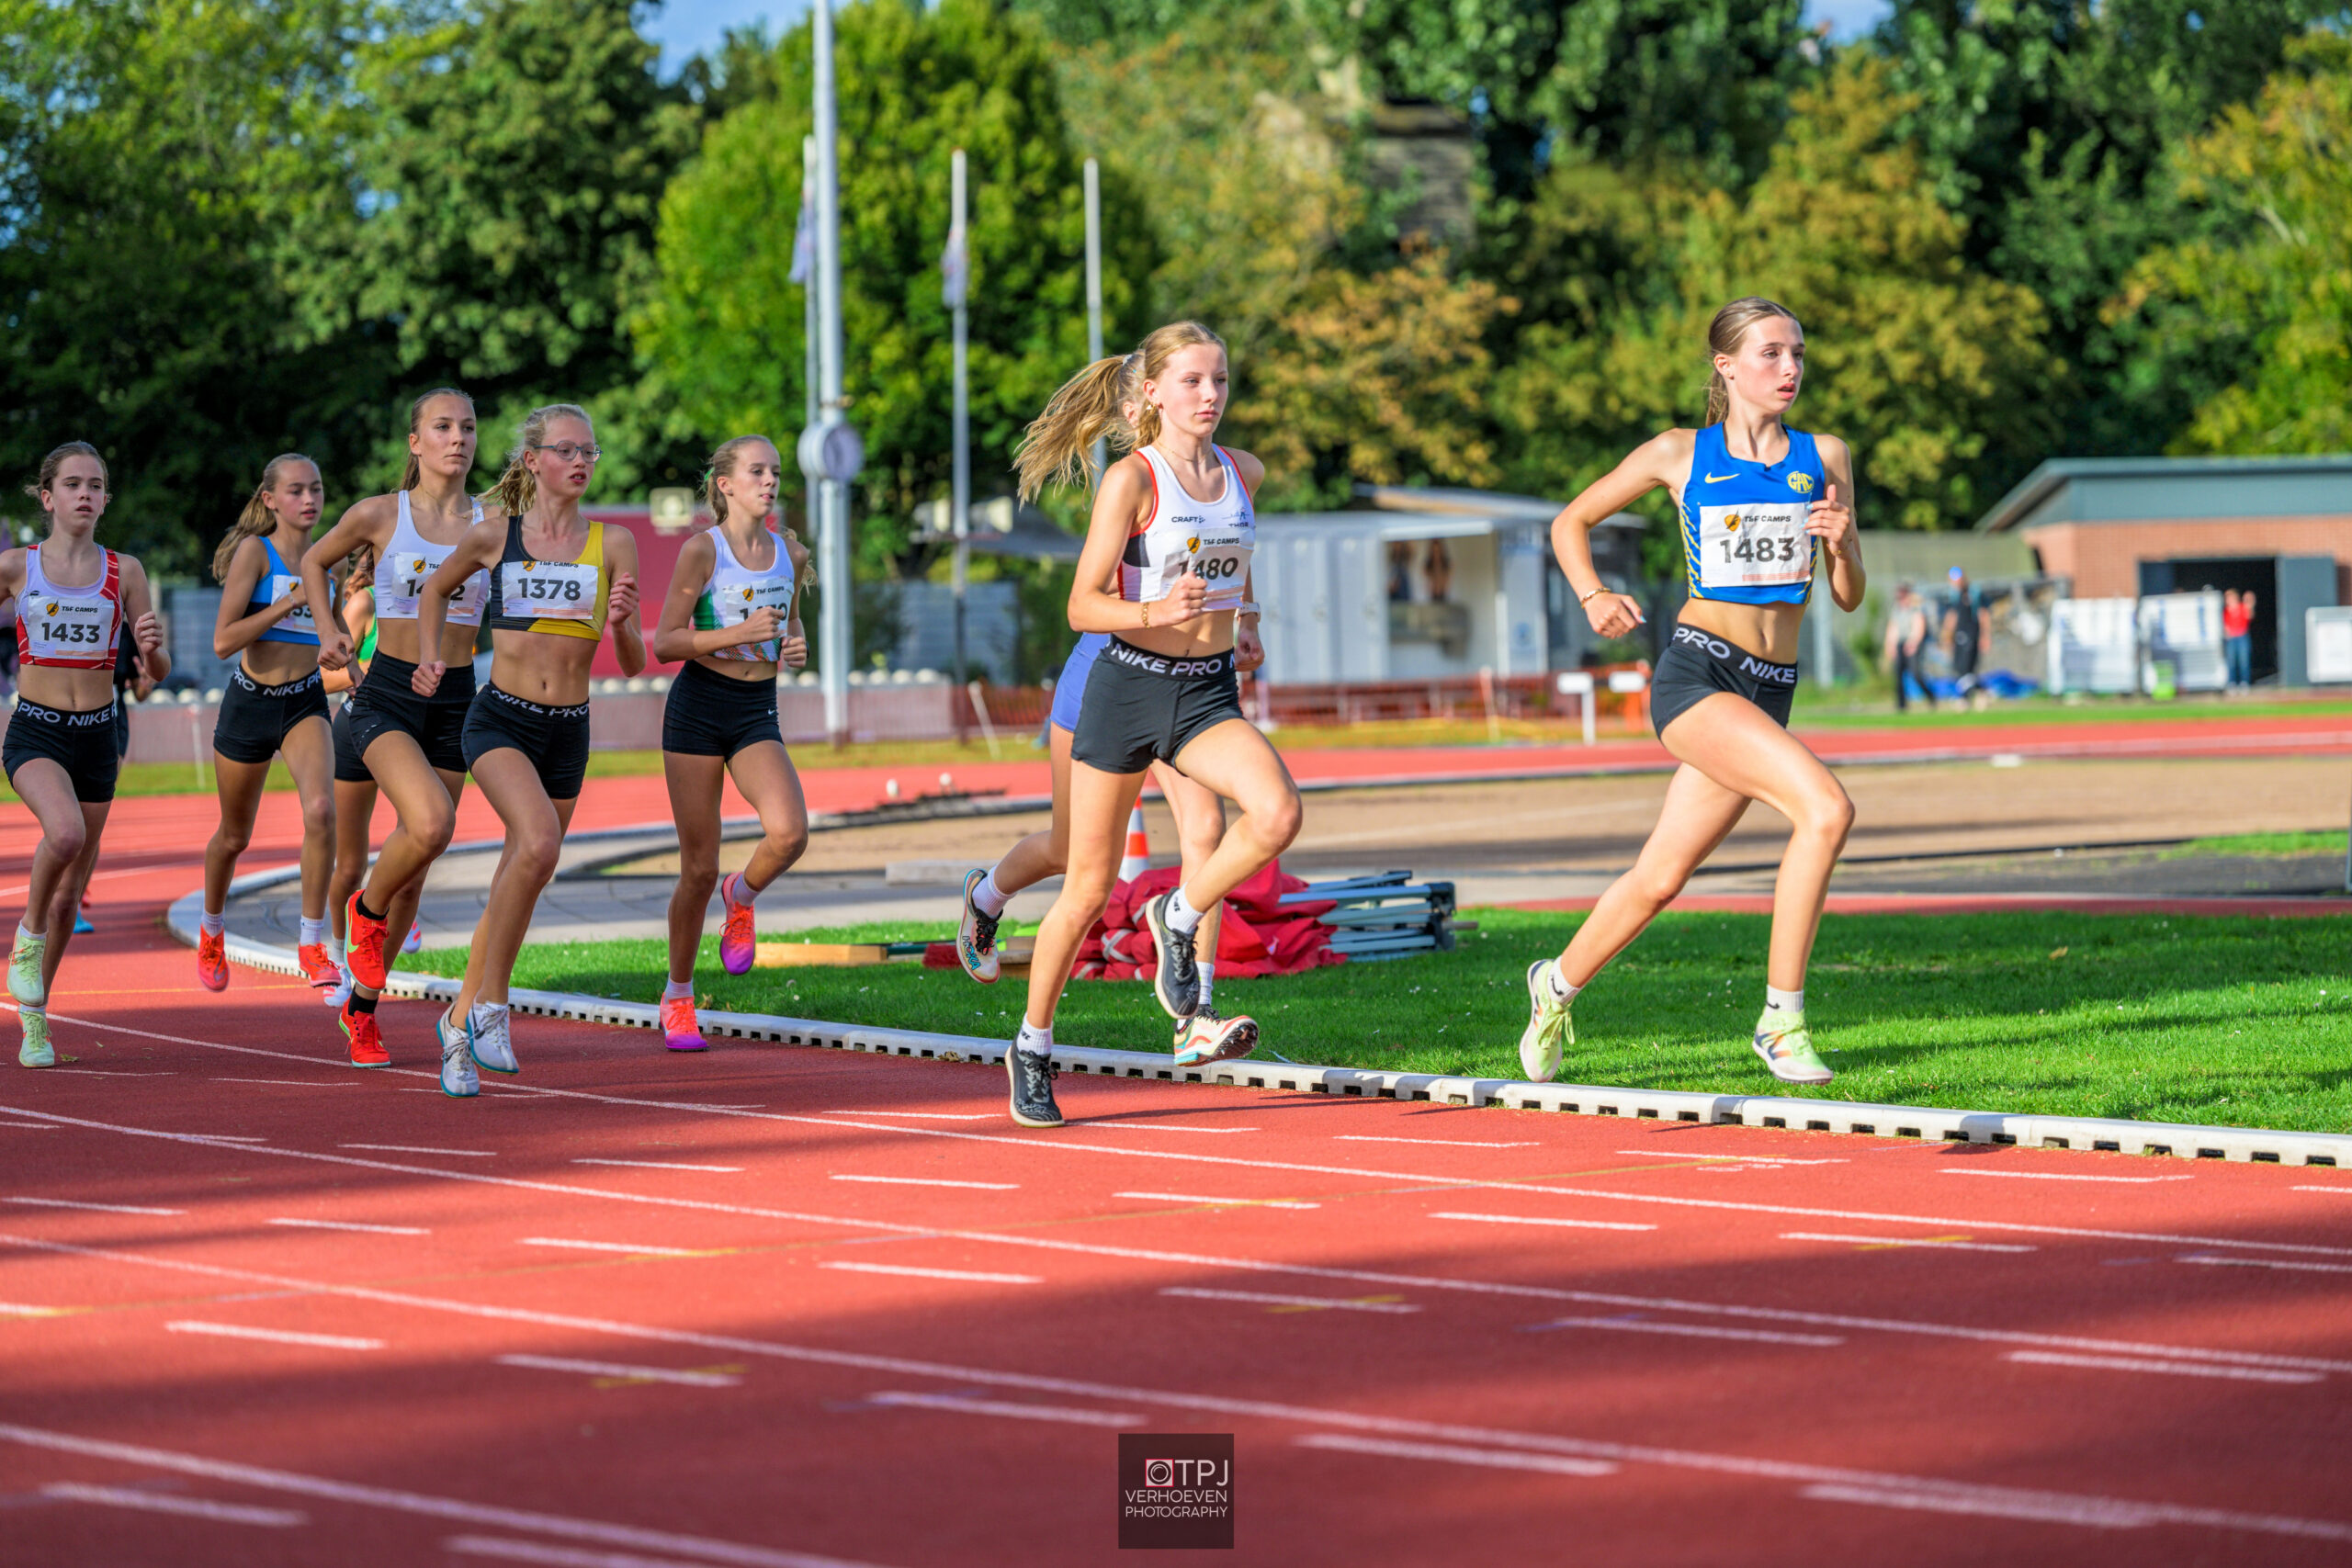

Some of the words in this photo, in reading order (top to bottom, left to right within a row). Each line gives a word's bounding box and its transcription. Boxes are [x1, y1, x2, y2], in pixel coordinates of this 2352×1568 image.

[1720, 537, 1794, 563] 1483
[407, 579, 466, 601] 12
[517, 578, 582, 601] 1378
[41, 623, 100, 644] 1433
[1110, 643, 1170, 674] NIKE
[1170, 659, 1222, 676] PRO
[1672, 626, 1731, 660] PRO
[1739, 656, 1795, 683] NIKE
[263, 680, 305, 696] NIKE
[18, 702, 61, 723] PRO
[67, 708, 110, 726] NIKE
